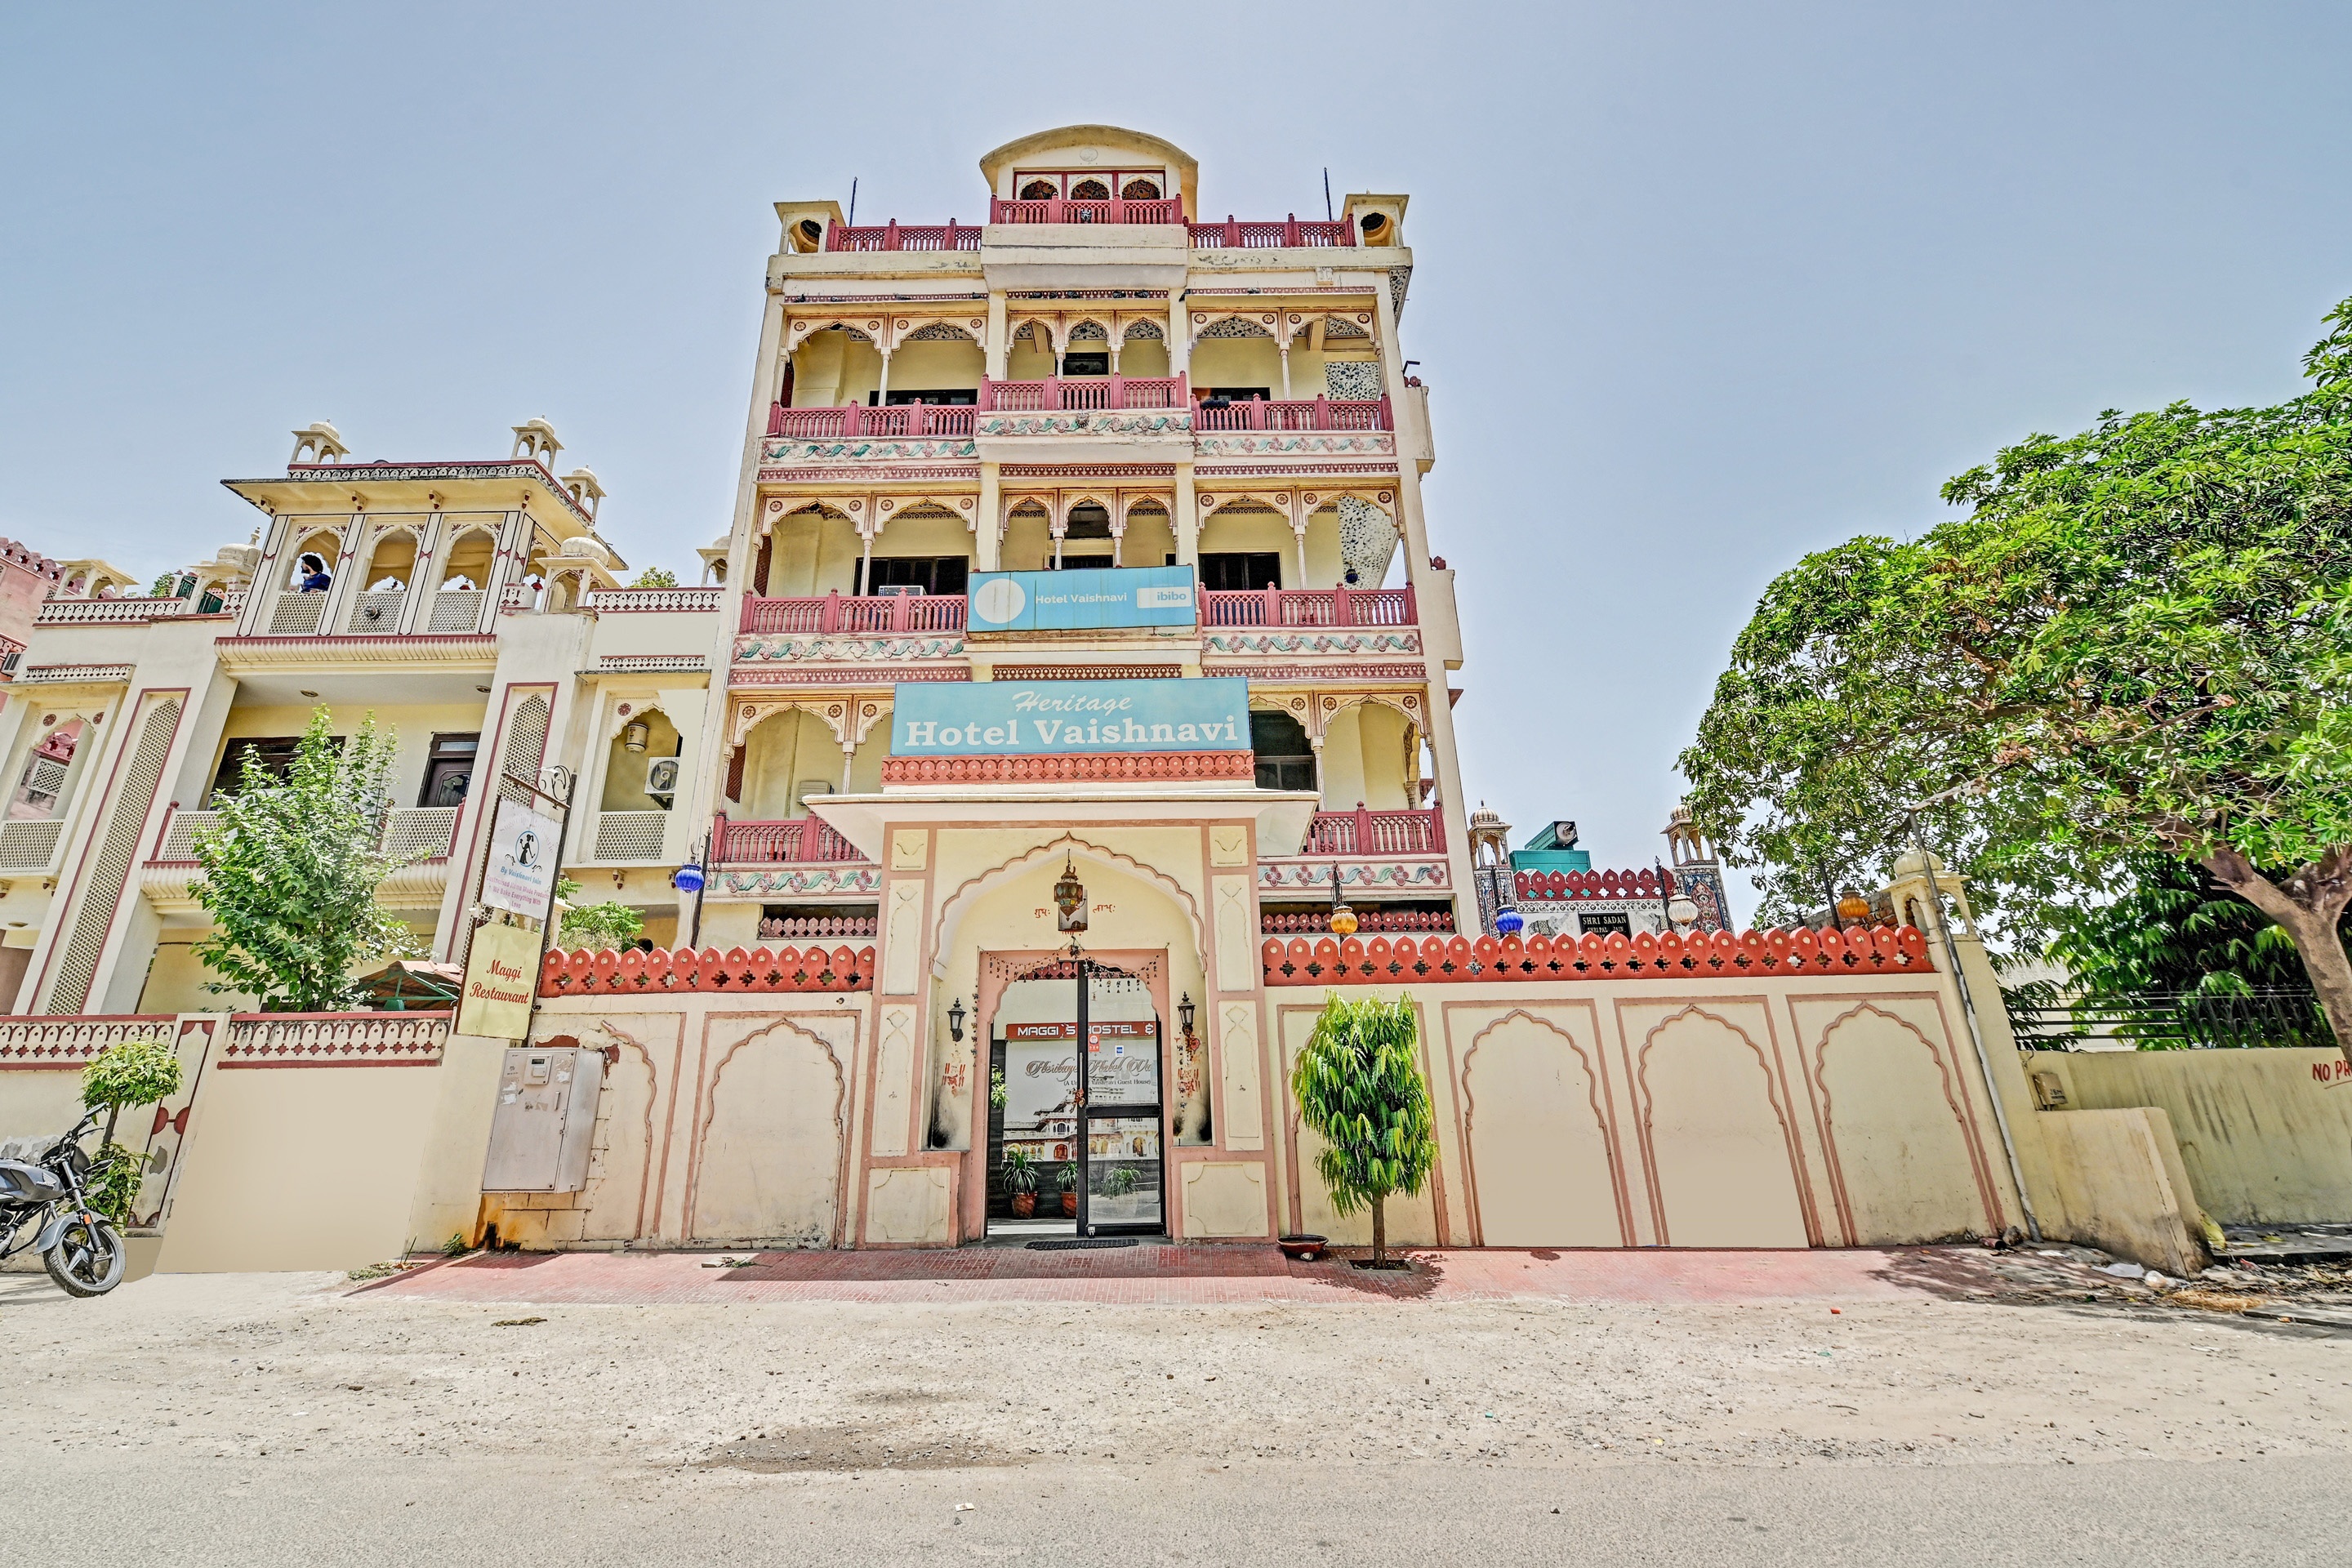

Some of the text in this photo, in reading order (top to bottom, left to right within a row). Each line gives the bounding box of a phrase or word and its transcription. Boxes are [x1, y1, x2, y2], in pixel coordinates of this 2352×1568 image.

[1036, 592, 1127, 604] Hotel Vaishnavi
[1157, 591, 1187, 601] ibibo
[1012, 691, 1133, 716] Heritage
[905, 715, 1238, 746] Hotel Vaishnavi
[500, 866, 507, 875] By
[509, 868, 532, 882] Vaishnavi
[501, 888, 511, 897] Bake
[511, 891, 532, 904] Everything
[532, 898, 541, 906] With
[511, 901, 522, 909] Love
[1582, 915, 1627, 925] SHRI SADAN
[486, 959, 523, 983] Maggi
[469, 982, 529, 1004] Restaurant
[1144, 1022, 1155, 1036] &
[2312, 1063, 2331, 1082] NO
